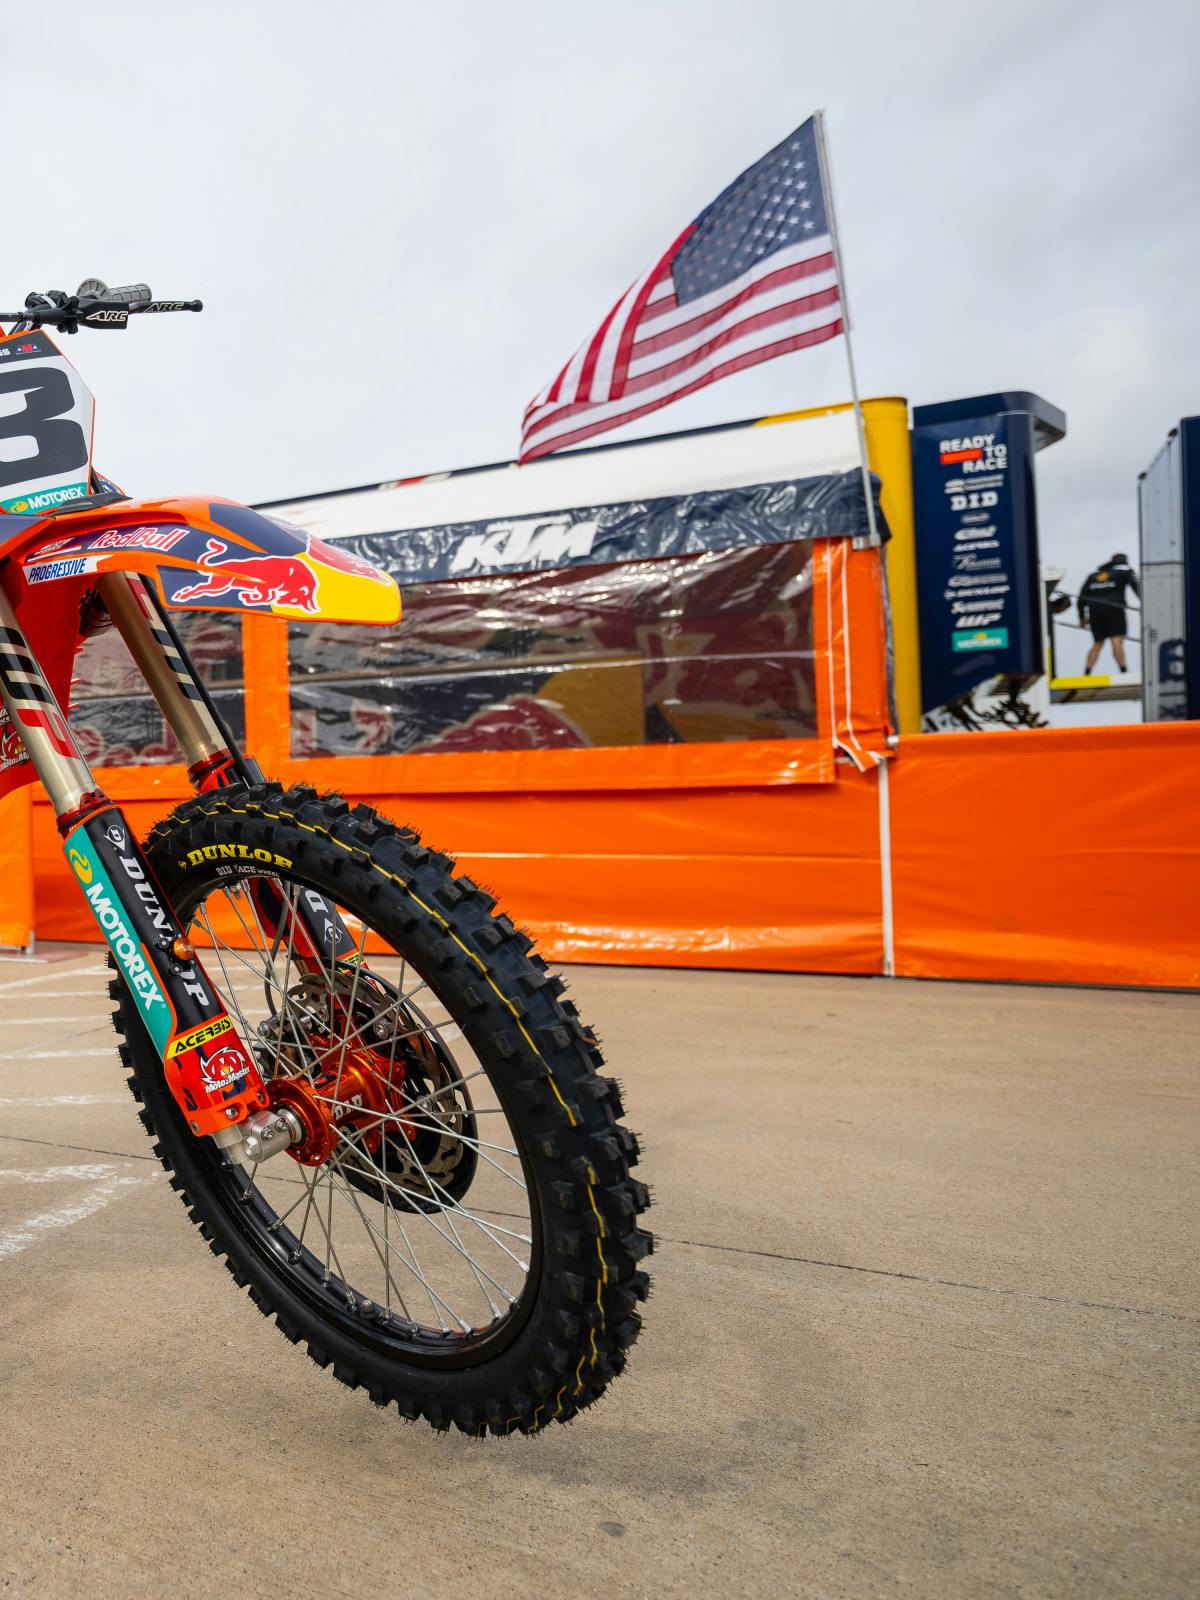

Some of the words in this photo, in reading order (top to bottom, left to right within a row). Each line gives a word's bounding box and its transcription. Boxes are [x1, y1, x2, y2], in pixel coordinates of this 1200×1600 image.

[86, 310, 128, 322] ARC
[144, 301, 185, 313] ARC
[939, 433, 996, 453] READY
[984, 443, 1008, 458] TO
[962, 457, 1008, 474] RACE
[27, 487, 84, 510] MOTOREX
[88, 527, 144, 550] Red
[130, 527, 190, 552] Bull
[451, 515, 600, 576] KTM
[28, 558, 87, 583] PROGRESSIVE
[186, 844, 293, 869] DUNLOP
[118, 855, 210, 1007] DUNP
[86, 882, 165, 1011] MOTOREX
[175, 1018, 231, 1054] ACERBIS
